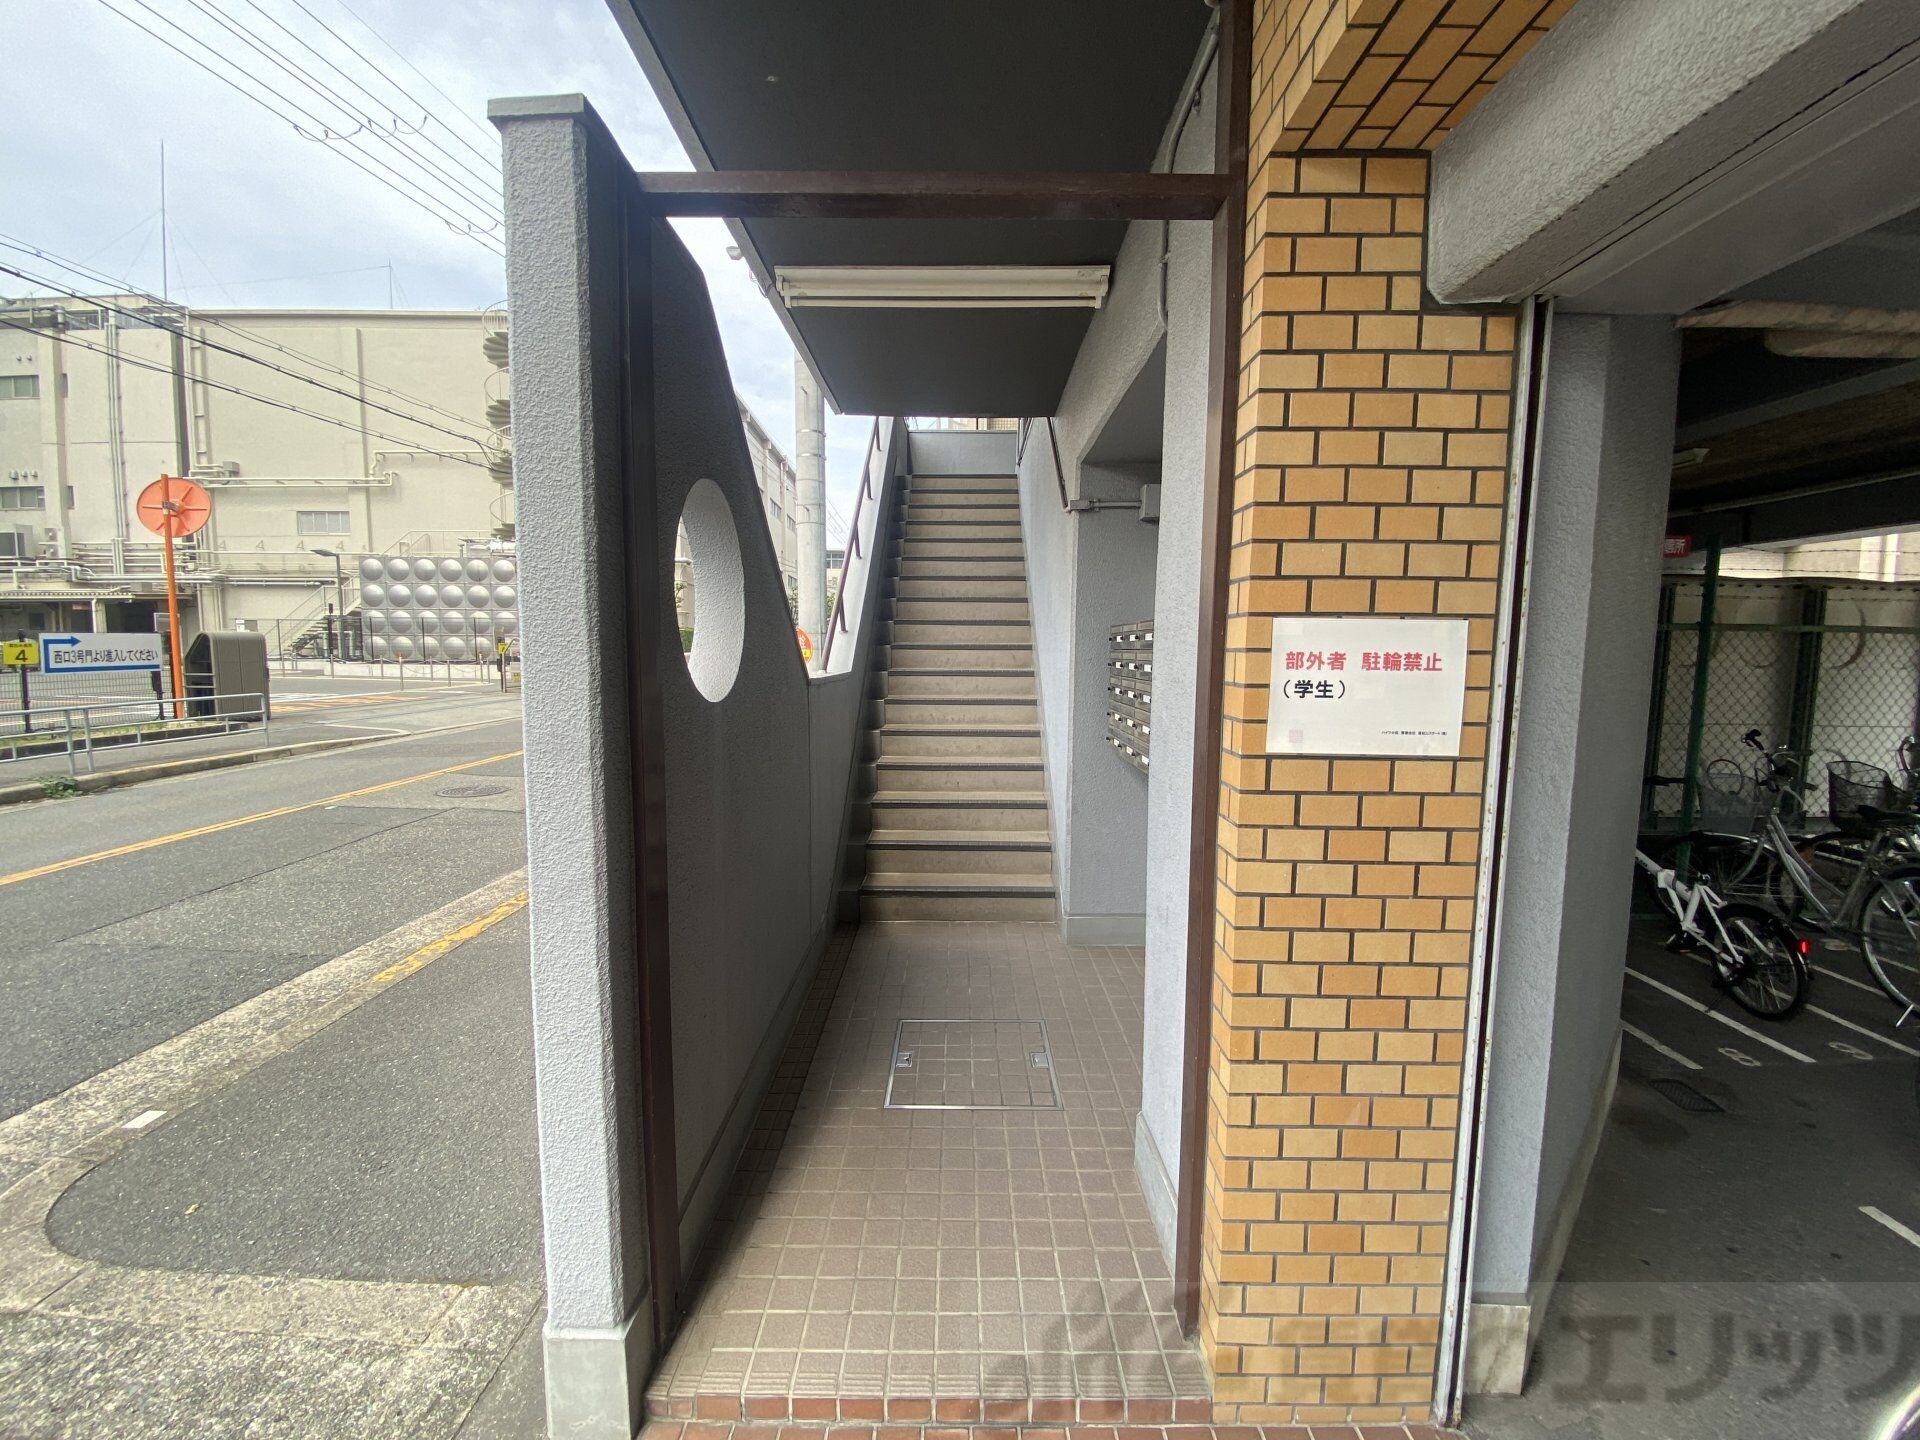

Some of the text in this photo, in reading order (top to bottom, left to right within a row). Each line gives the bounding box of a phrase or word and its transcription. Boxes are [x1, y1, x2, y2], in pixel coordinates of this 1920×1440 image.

[15, 649, 28, 662] 4
[54, 649, 158, 664] 西口3号門より進入してください
[1285, 651, 1443, 672] 部外者 駐輪禁止
[1283, 680, 1346, 699] (学生)
